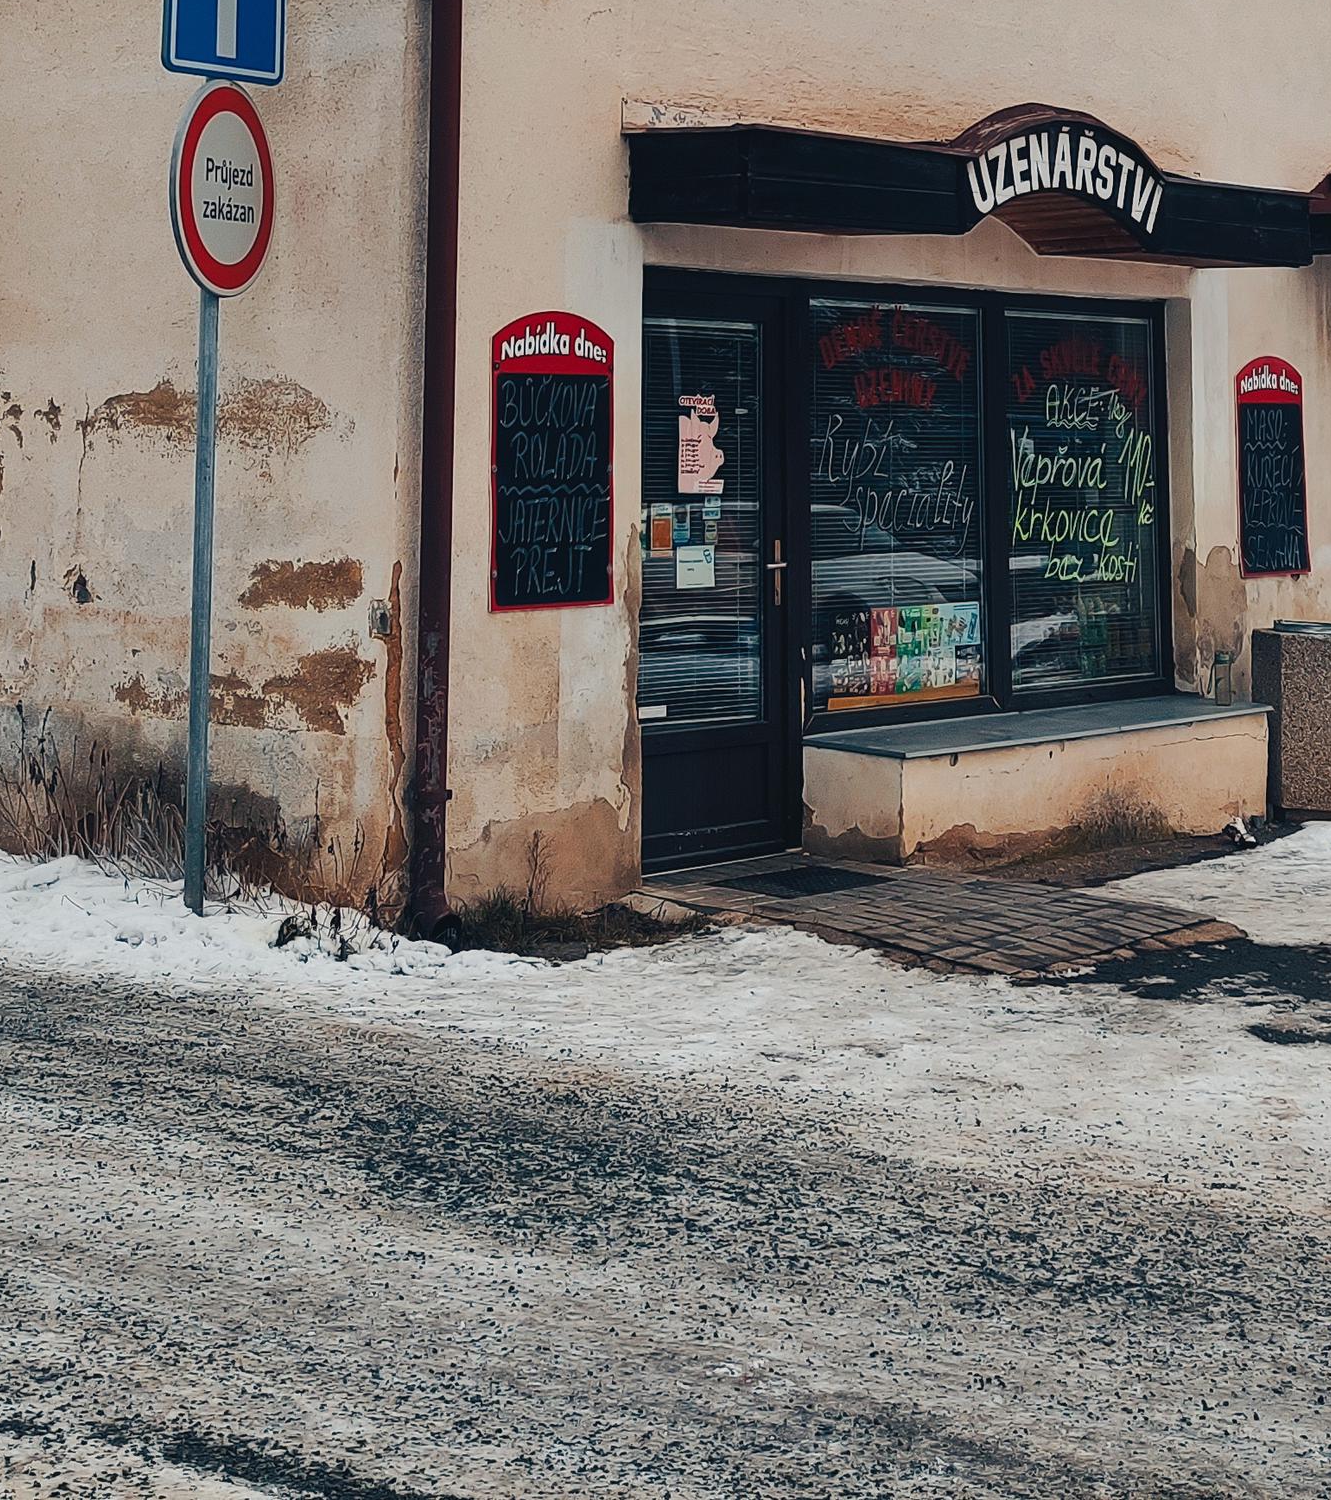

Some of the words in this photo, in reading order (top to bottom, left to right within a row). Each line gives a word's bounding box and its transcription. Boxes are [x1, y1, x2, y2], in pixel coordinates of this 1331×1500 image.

[205, 157, 254, 191] Průjezd
[202, 195, 255, 224] zakázan
[501, 322, 570, 361] Nabídka
[574, 328, 607, 364] dne:
[500, 375, 609, 429] BŮČKOVÁ
[1241, 365, 1278, 395] Nabídka
[509, 422, 599, 480] ROLÁDA
[1010, 425, 1108, 505] Vepřová
[498, 494, 611, 546] JATERNICE
